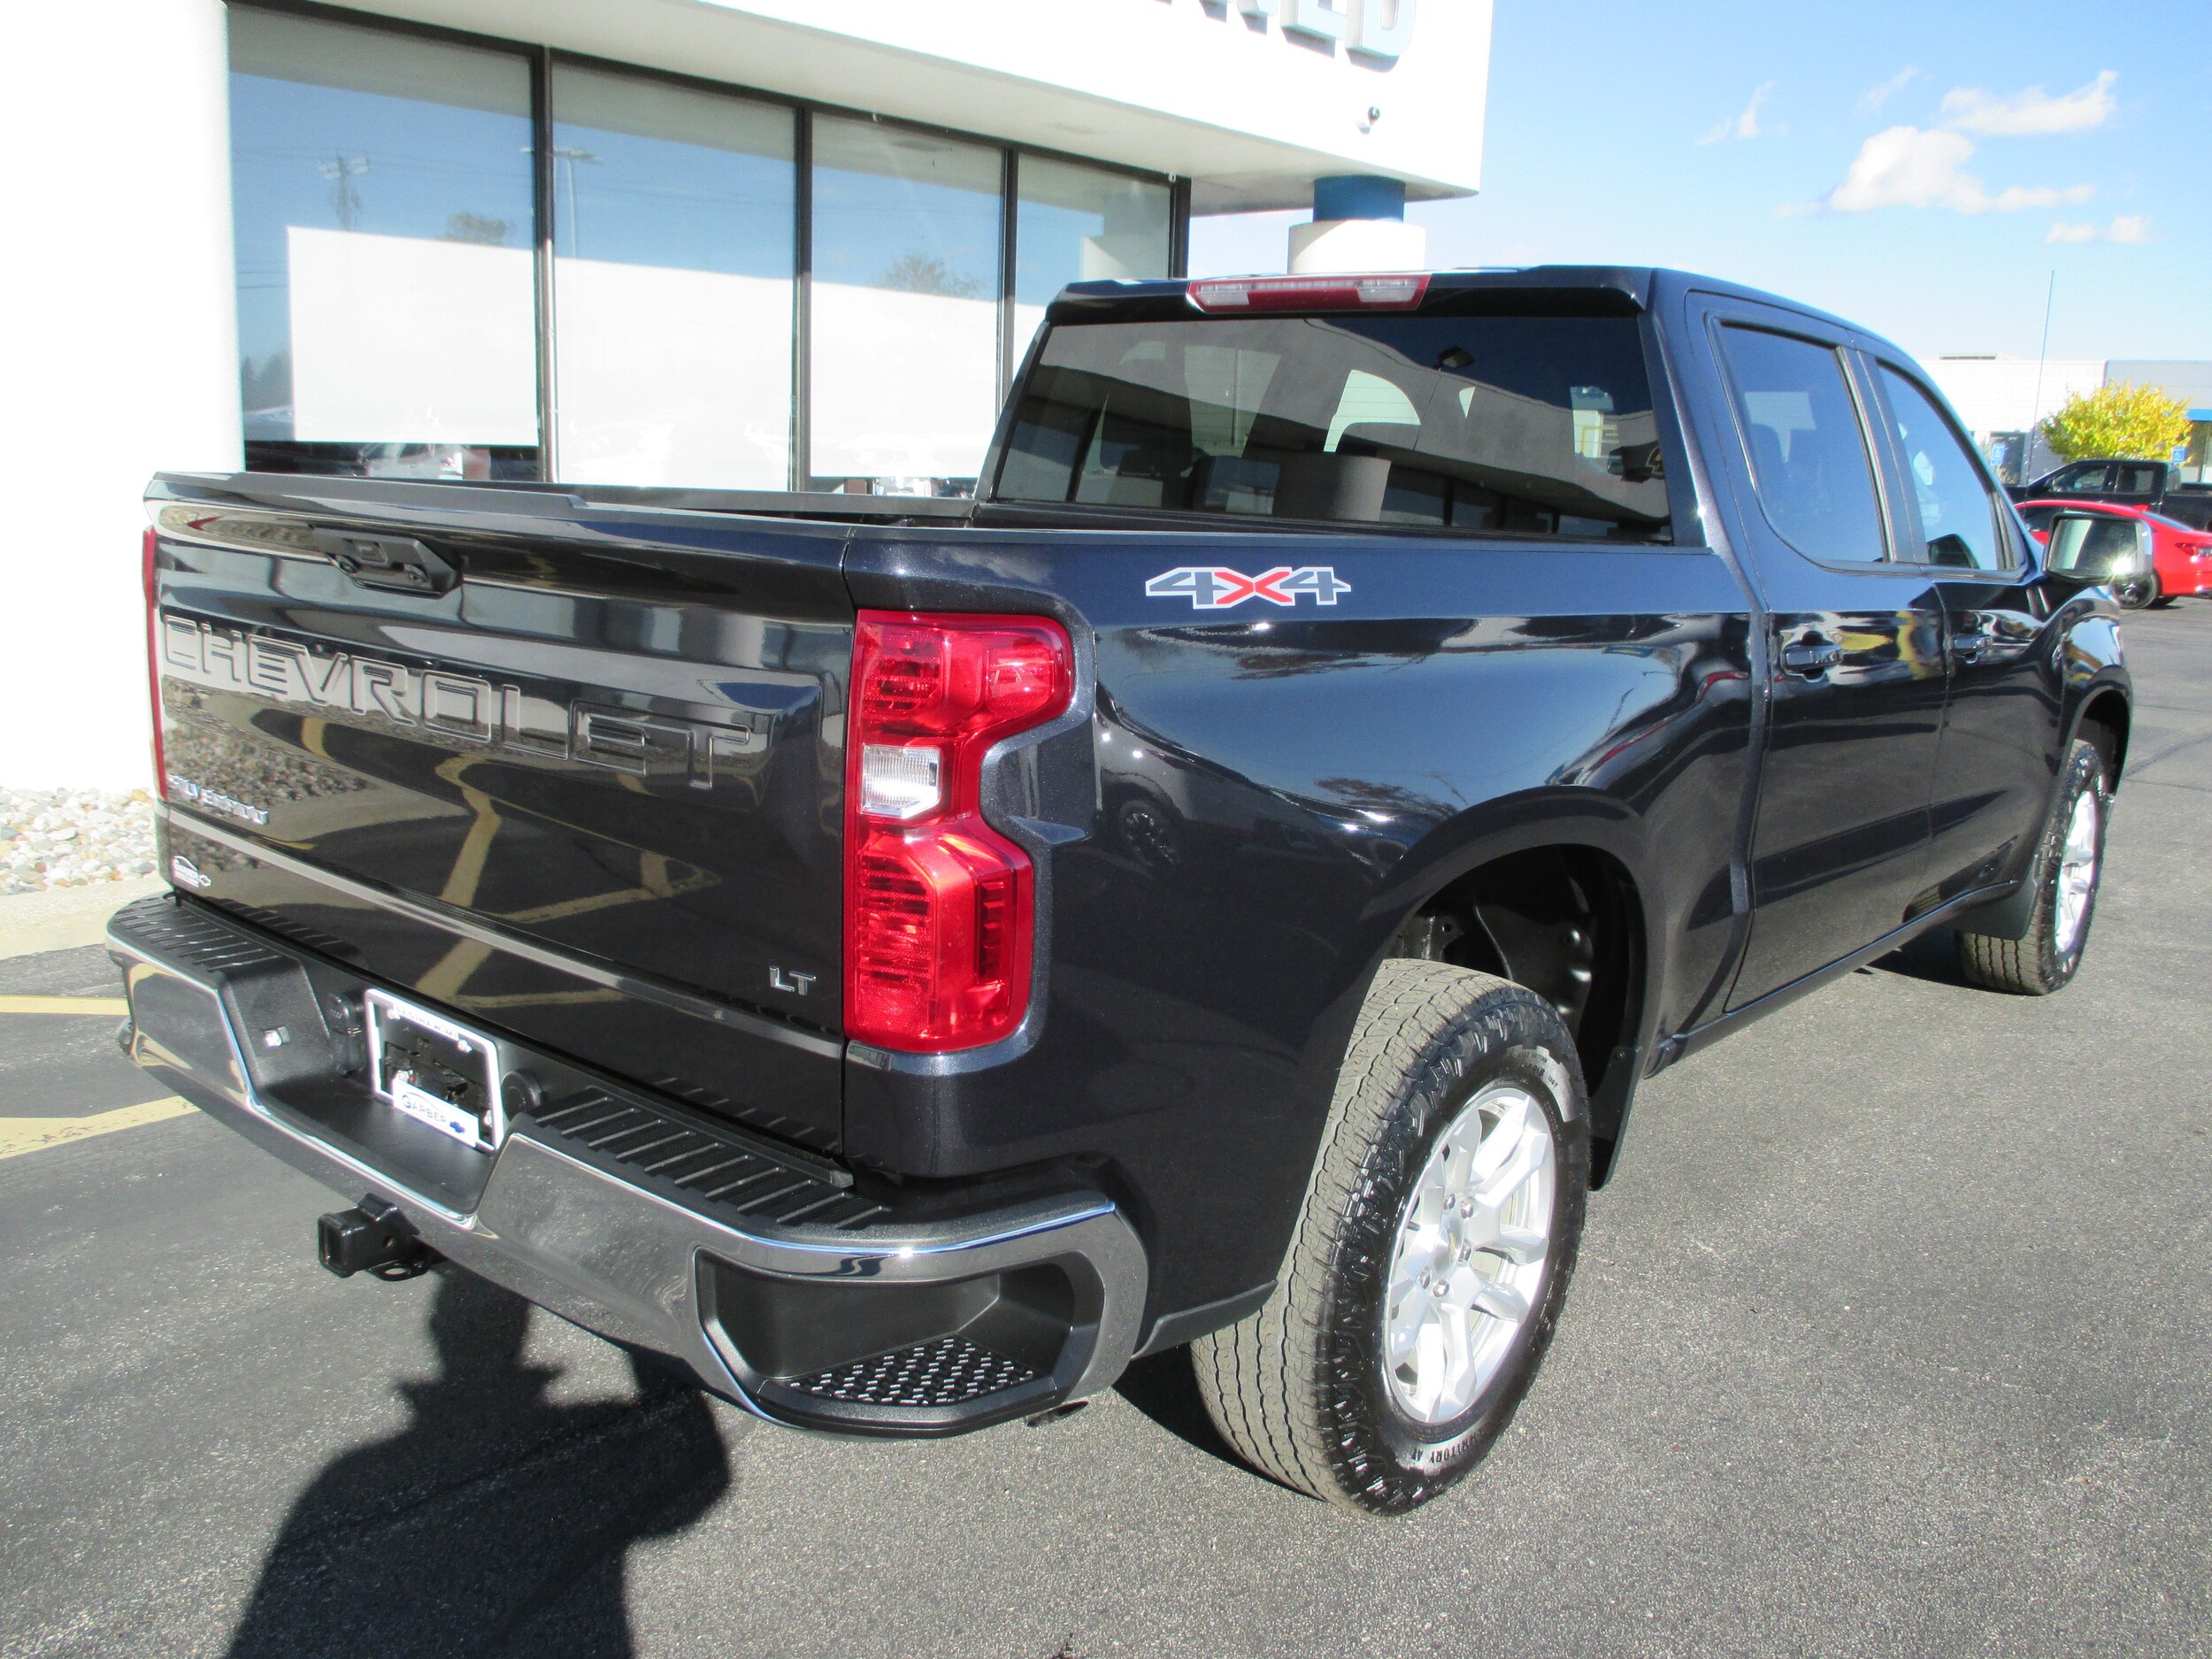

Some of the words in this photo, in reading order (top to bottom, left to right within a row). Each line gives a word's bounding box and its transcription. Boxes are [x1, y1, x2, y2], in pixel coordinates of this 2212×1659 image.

[165, 614, 750, 789] CHEVROLET
[769, 964, 817, 996] LT
[402, 1094, 447, 1124] GARBER
